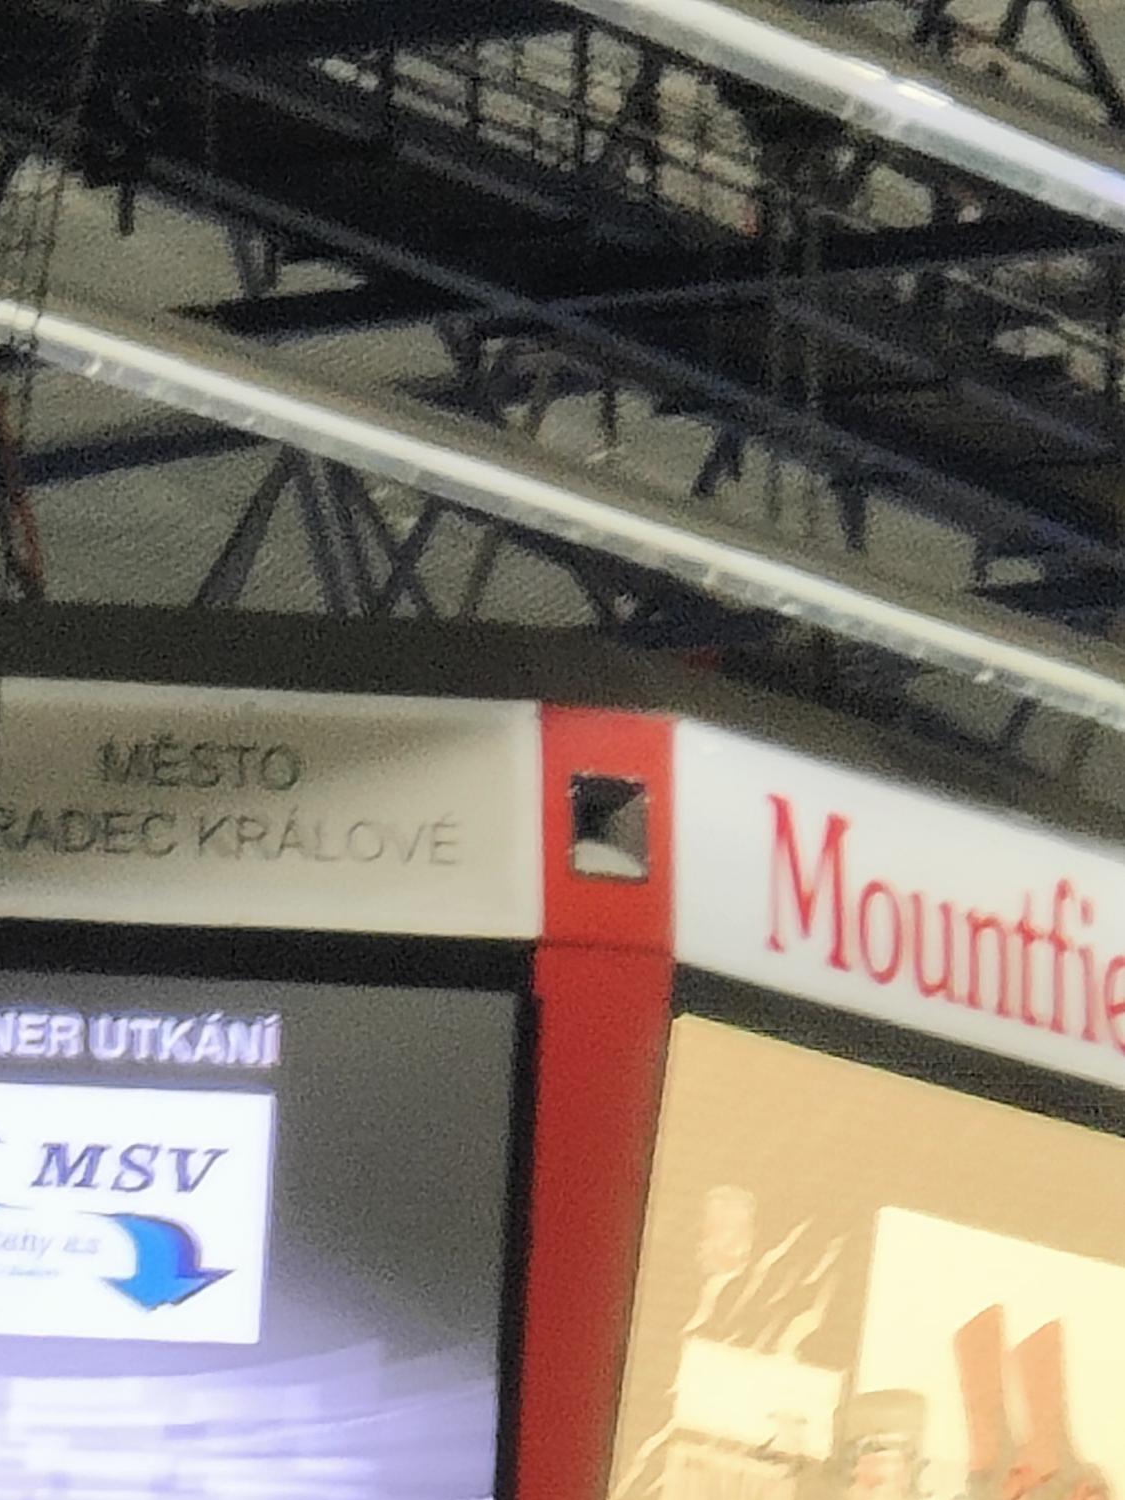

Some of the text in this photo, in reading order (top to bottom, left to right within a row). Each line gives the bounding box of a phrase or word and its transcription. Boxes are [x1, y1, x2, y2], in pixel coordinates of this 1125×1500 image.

[197, 803, 462, 866] KRÁLOVÉ
[88, 1011, 282, 1067] UTKÁNÍ
[30, 1140, 229, 1193] MSV
